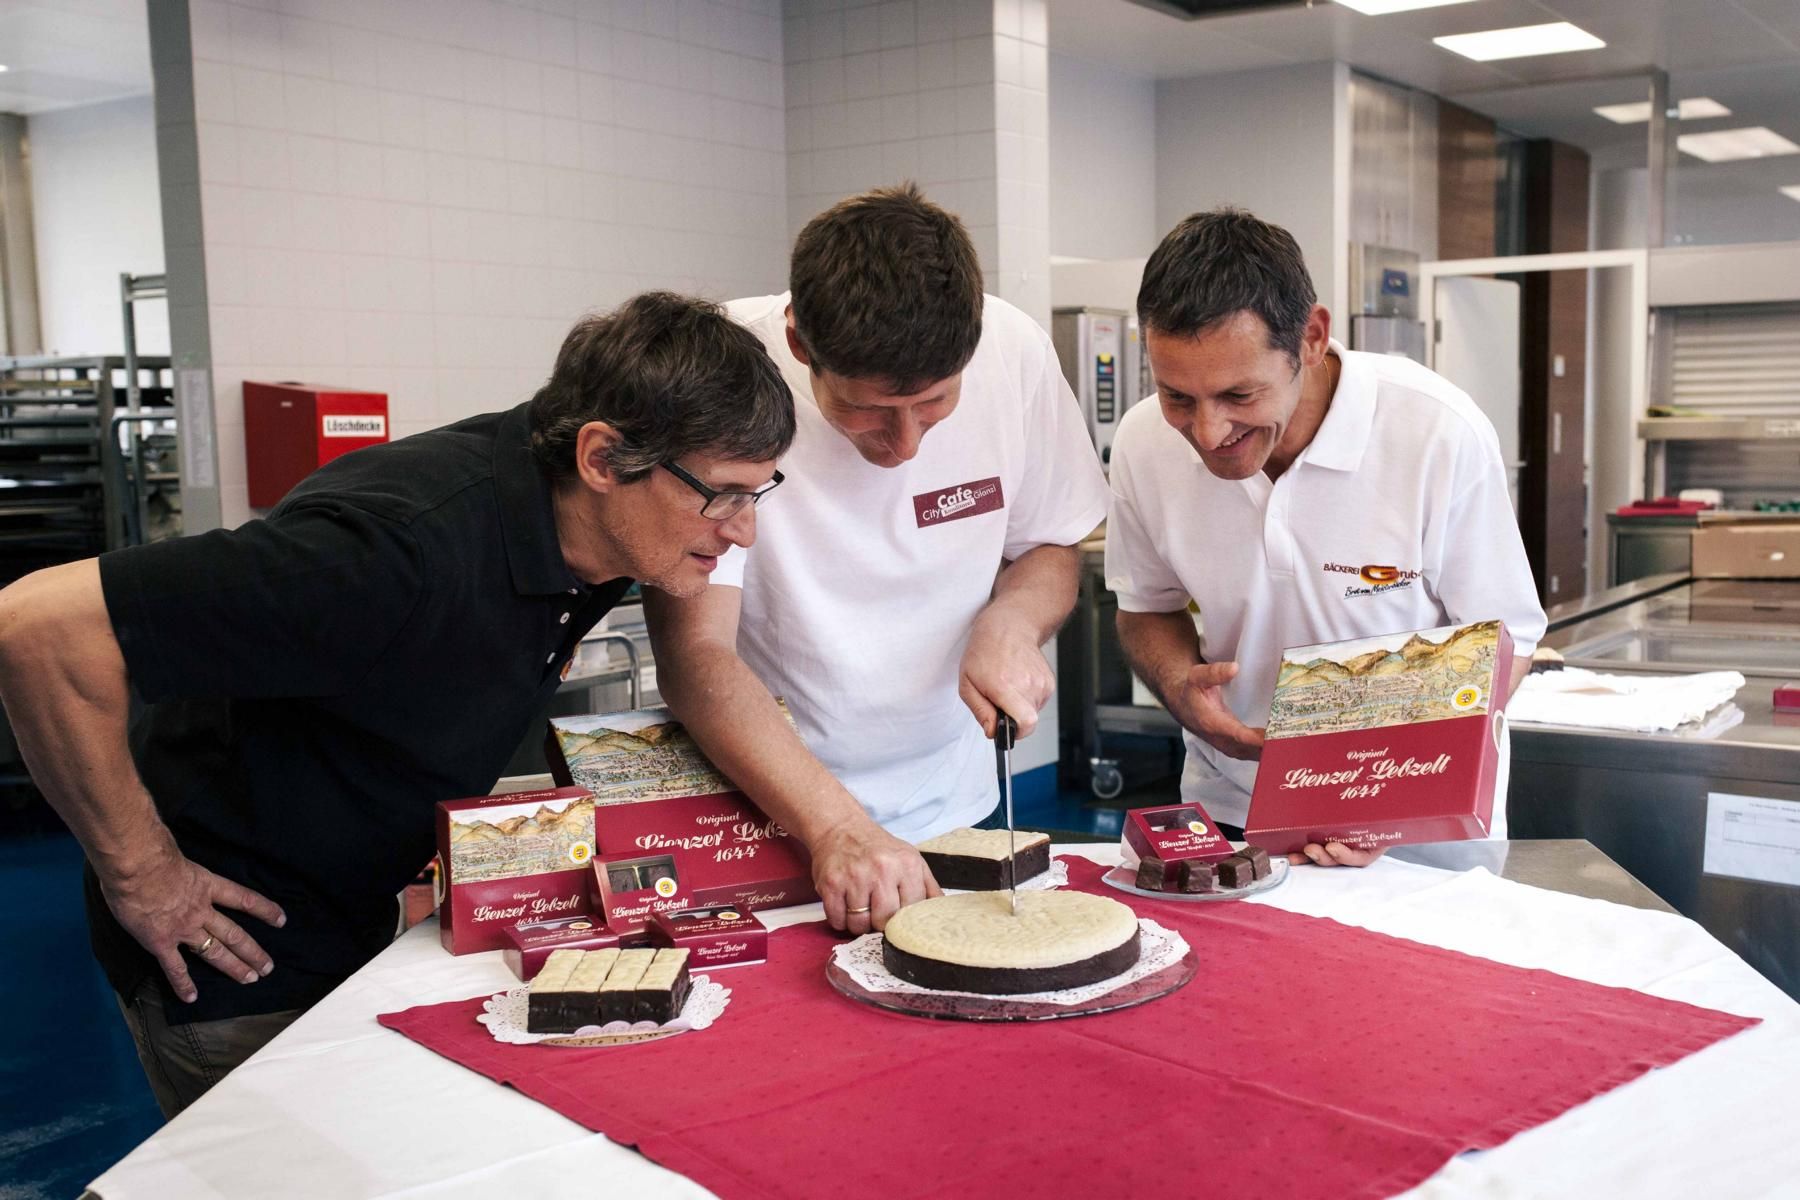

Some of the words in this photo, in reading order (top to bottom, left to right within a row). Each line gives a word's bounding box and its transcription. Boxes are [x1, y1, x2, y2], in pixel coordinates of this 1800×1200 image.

[326, 418, 381, 432] Löschdecke
[922, 508, 941, 521] City
[937, 487, 973, 510] Cafe
[1323, 562, 1360, 575] BÄCKEREI
[1346, 747, 1390, 762] Original
[1279, 767, 1364, 790] Lienzer
[1366, 753, 1453, 781] Lebzelt
[695, 811, 740, 827] Original
[732, 820, 790, 843] Lebz
[513, 890, 540, 901] Original
[472, 904, 527, 922] Lienzer
[529, 894, 580, 914] Lebzelt
[612, 904, 651, 918] Lienzer
[653, 897, 689, 912] Lebzelt
